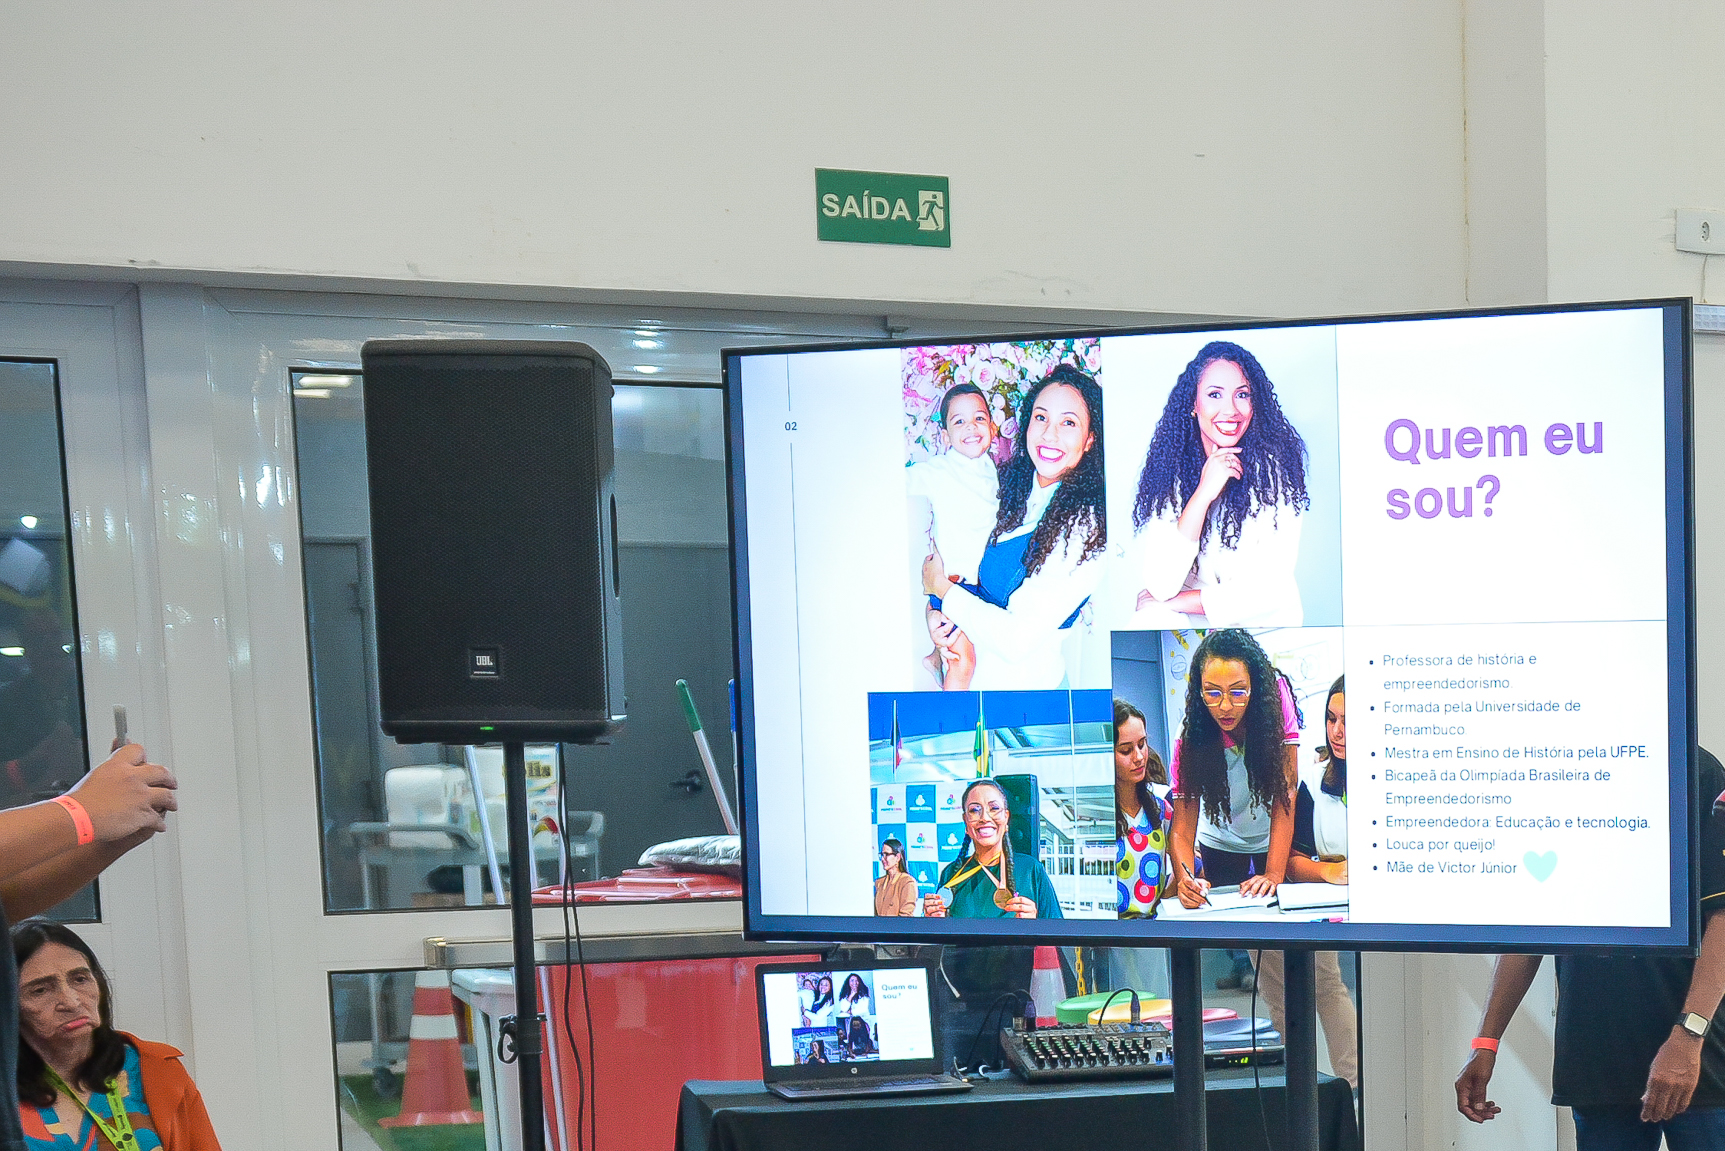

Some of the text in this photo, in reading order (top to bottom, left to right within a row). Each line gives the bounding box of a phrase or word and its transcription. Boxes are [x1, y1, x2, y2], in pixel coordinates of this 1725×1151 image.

[822, 190, 912, 221] SAÍDA
[784, 421, 797, 431] 02
[1385, 418, 1603, 464] Quem eu
[1386, 474, 1500, 520] sou?
[476, 655, 493, 666] JBL
[1383, 653, 1537, 666] Professora de história e
[1384, 700, 1581, 715] Formada pela Universidade de
[1385, 745, 1649, 761] Mestra em Ensino de História pela UFPE.
[1440, 770, 1456, 781] da
[1460, 769, 1526, 784] Olimpíada
[1529, 769, 1590, 781] Brasileira
[1594, 769, 1611, 781] de
[1386, 792, 1512, 807] Empreendedorismo
[1386, 815, 1651, 832] Empreendedora: Educação e tecnologia.
[1387, 838, 1495, 853] Louca por queijo!
[1387, 861, 1518, 874] Mãe de Victor Júnior
